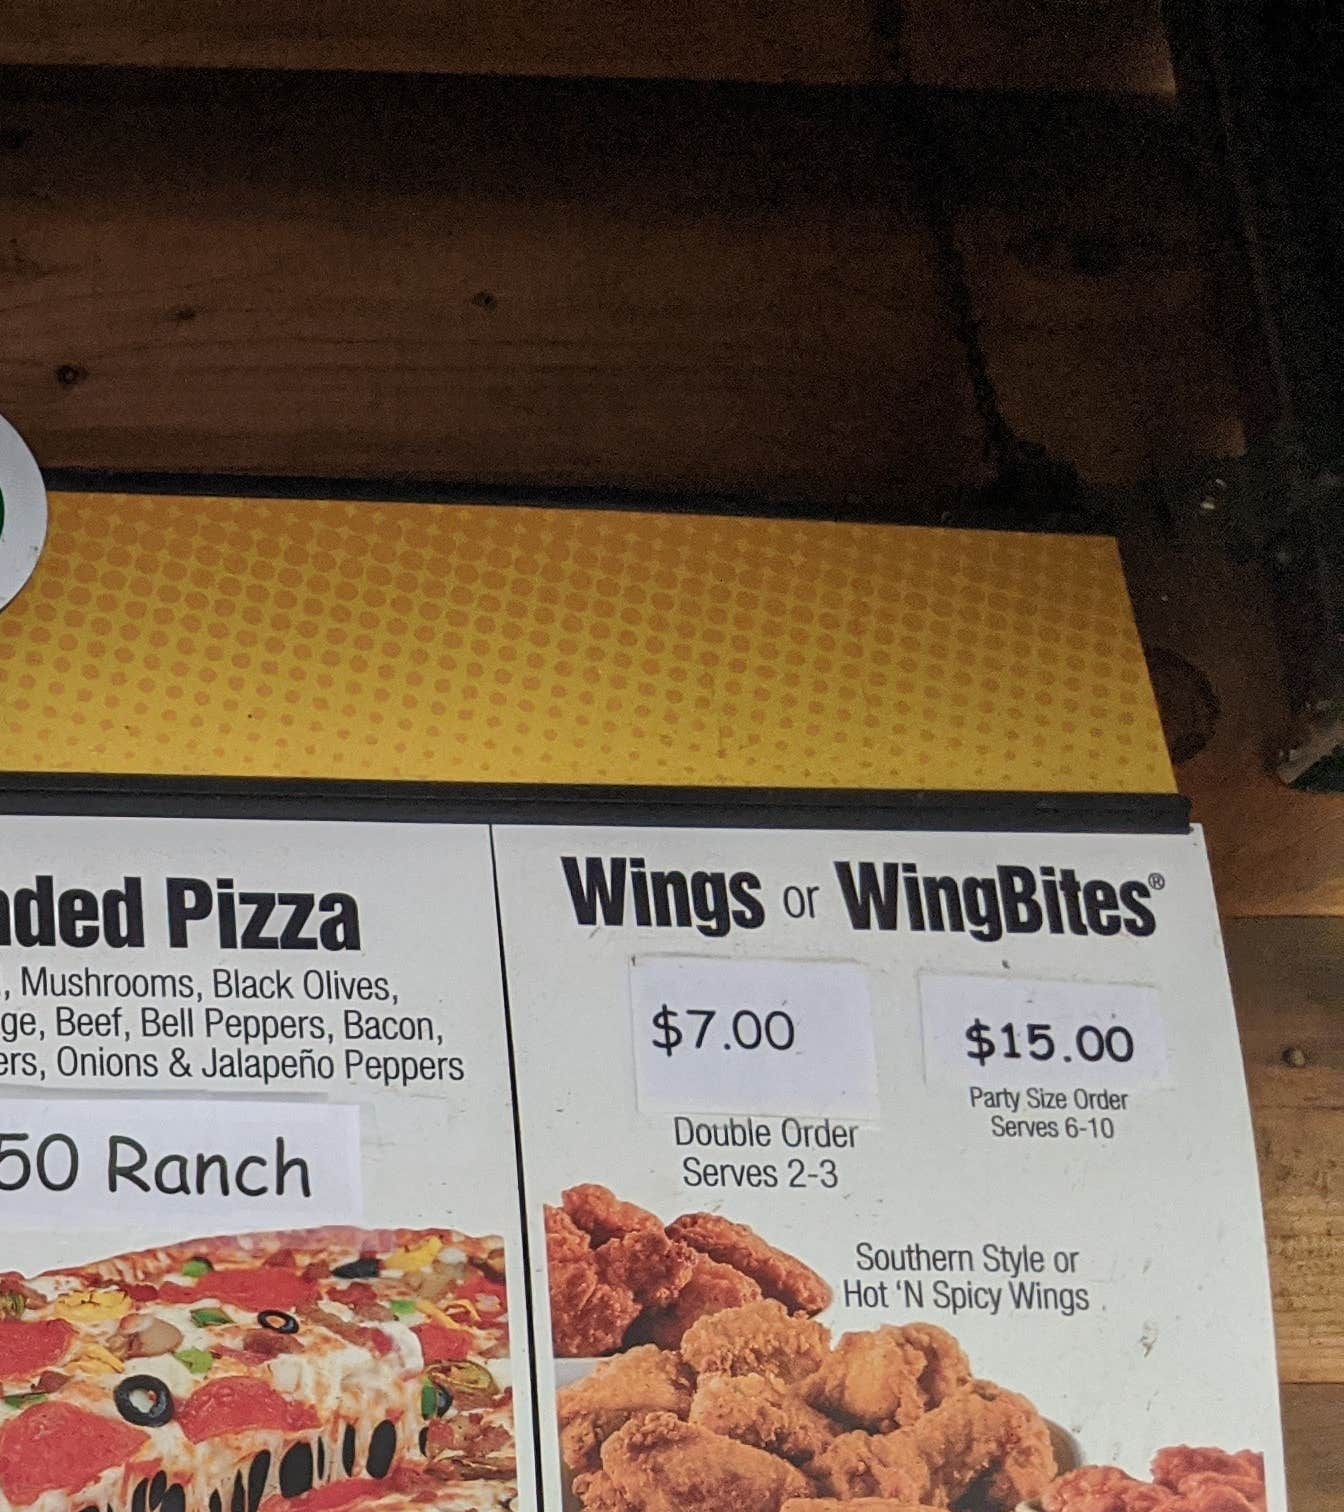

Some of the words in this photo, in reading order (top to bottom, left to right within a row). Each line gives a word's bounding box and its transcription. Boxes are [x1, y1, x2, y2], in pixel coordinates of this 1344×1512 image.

[166, 878, 360, 951] Pizza
[561, 856, 765, 937] Wings
[784, 886, 819, 918] or
[22, 967, 202, 1002] Mushrooms,
[213, 969, 294, 999] Black
[304, 970, 397, 1005] Olives,
[56, 1007, 129, 1041] Beef,
[142, 1007, 193, 1037] Bell
[206, 1008, 333, 1045] Peppers,
[344, 1010, 442, 1045] Bacon,
[653, 1004, 794, 1057] $7.00
[966, 1019, 1133, 1066] $15.00
[58, 1046, 158, 1077] Onions
[169, 1048, 192, 1077] &
[202, 1048, 334, 1085] Jalapeño
[345, 1049, 464, 1086] Peppers
[970, 1087, 1020, 1113] Party
[1026, 1088, 1067, 1109] Size
[1074, 1088, 1128, 1110] Order
[674, 1117, 771, 1146] Double
[782, 1118, 858, 1147] Order
[991, 1115, 1059, 1137] Serves
[1065, 1117, 1114, 1138] 6-10
[108, 1136, 310, 1197] Ranch
[683, 1157, 777, 1187] Serves
[788, 1159, 838, 1188] 2-3
[857, 1243, 973, 1271] Southern
[983, 1244, 1044, 1278] Style
[1054, 1252, 1079, 1273] or
[844, 1280, 888, 1307] Hot
[933, 1280, 1002, 1315] Spicy
[1009, 1281, 1089, 1316] Wings
